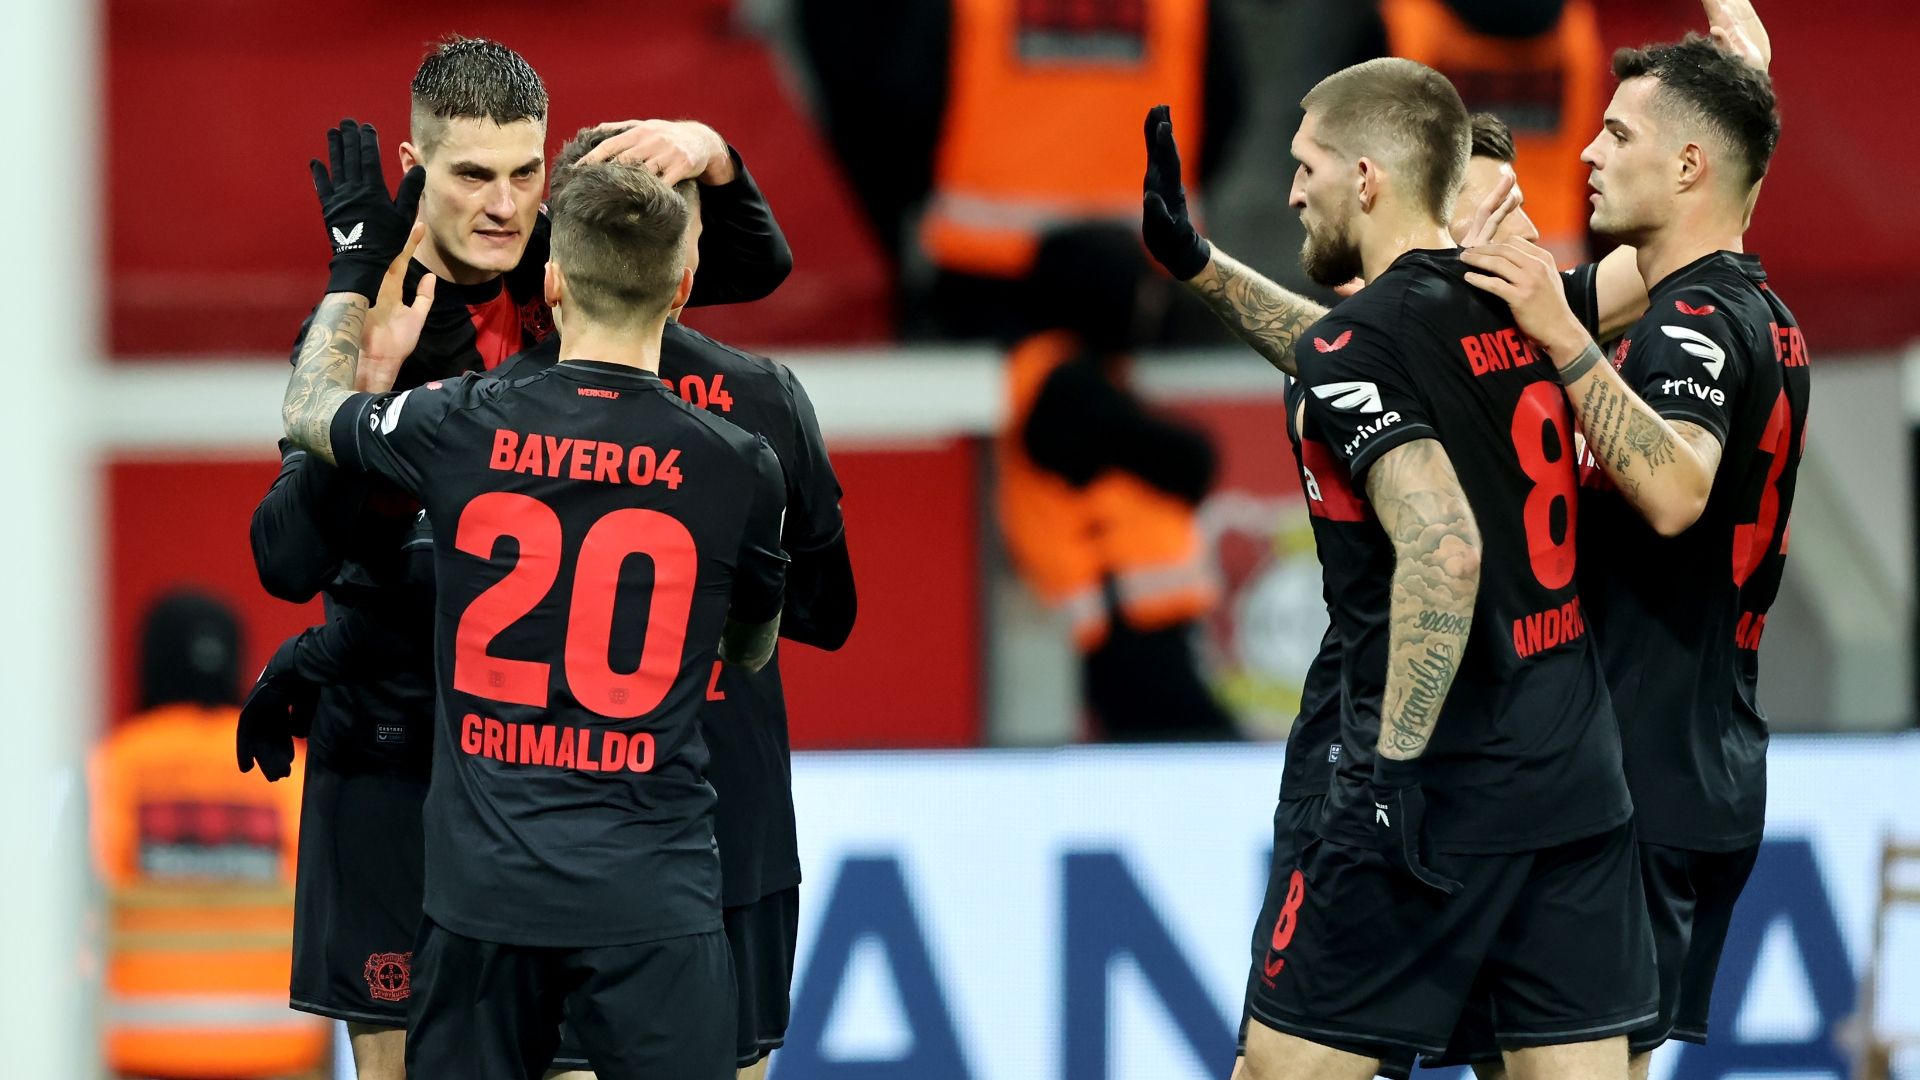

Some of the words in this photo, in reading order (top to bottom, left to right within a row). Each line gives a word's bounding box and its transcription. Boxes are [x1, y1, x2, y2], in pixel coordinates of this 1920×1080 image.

[577, 387, 620, 400] WERKSELF
[1661, 377, 1725, 407] trive
[489, 428, 622, 484] BAYER
[627, 445, 684, 490] 04
[1344, 410, 1402, 456] trive
[1511, 381, 1578, 589] 8
[453, 491, 699, 719] 20
[460, 713, 656, 774] GRIMALDO
[1272, 869, 1305, 951] 8
